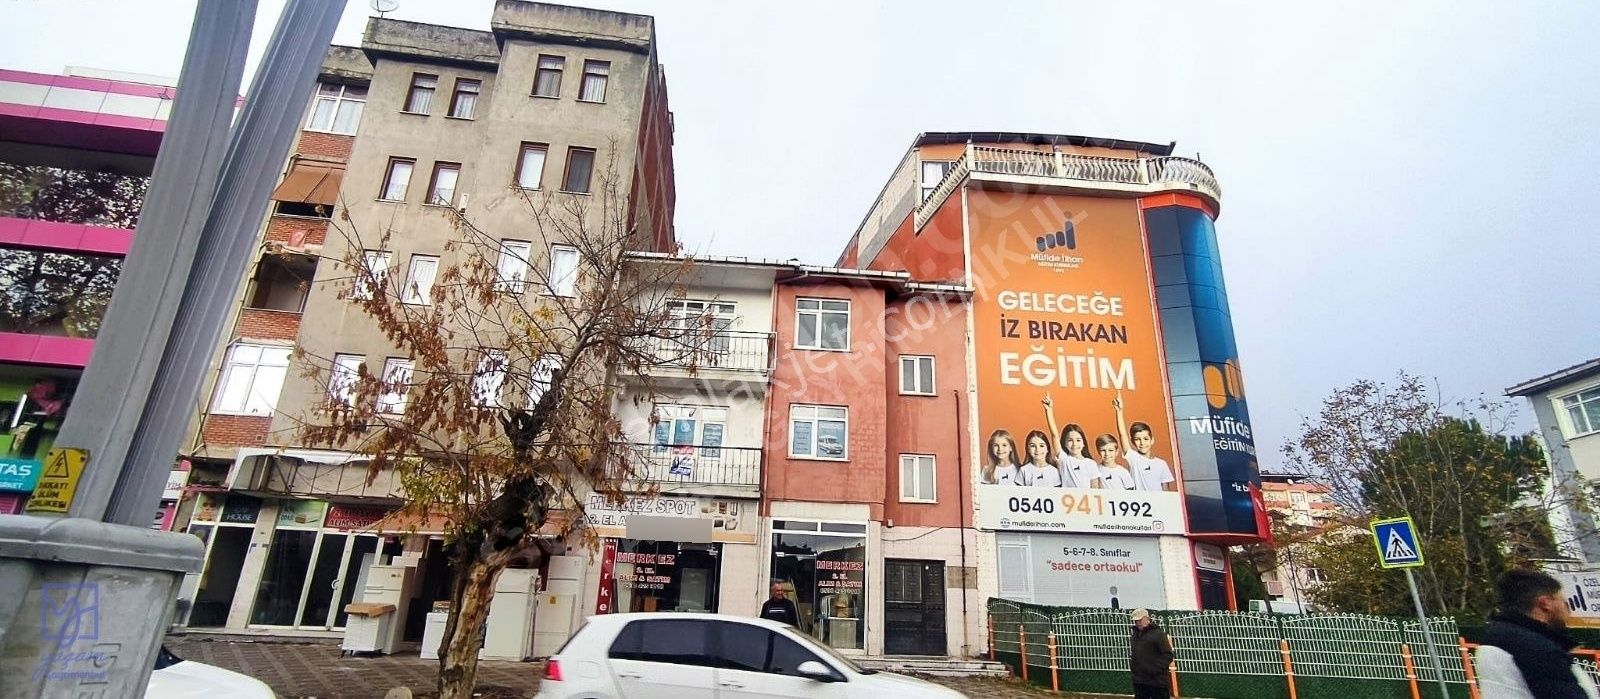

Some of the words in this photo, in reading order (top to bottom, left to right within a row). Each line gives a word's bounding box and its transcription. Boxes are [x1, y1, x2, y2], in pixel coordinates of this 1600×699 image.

[997, 290, 1124, 317] GELECEĞE
[1000, 313, 1020, 339] İZ
[1028, 320, 1128, 344] BIRAKAN
[1000, 344, 1136, 391] EĞİTİM
[1189, 415, 1251, 439] Müfide
[590, 495, 655, 514] MERKEZ
[655, 499, 696, 515] SPOT
[1008, 496, 1054, 514] 0540
[1061, 494, 1104, 516] 941
[1108, 500, 1152, 517] 1992
[602, 515, 617, 526] EL
[1063, 547, 1098, 557] 5-6-7-8.
[1100, 548, 1131, 558] Sınıflar
[816, 560, 864, 571] MERKEZ
